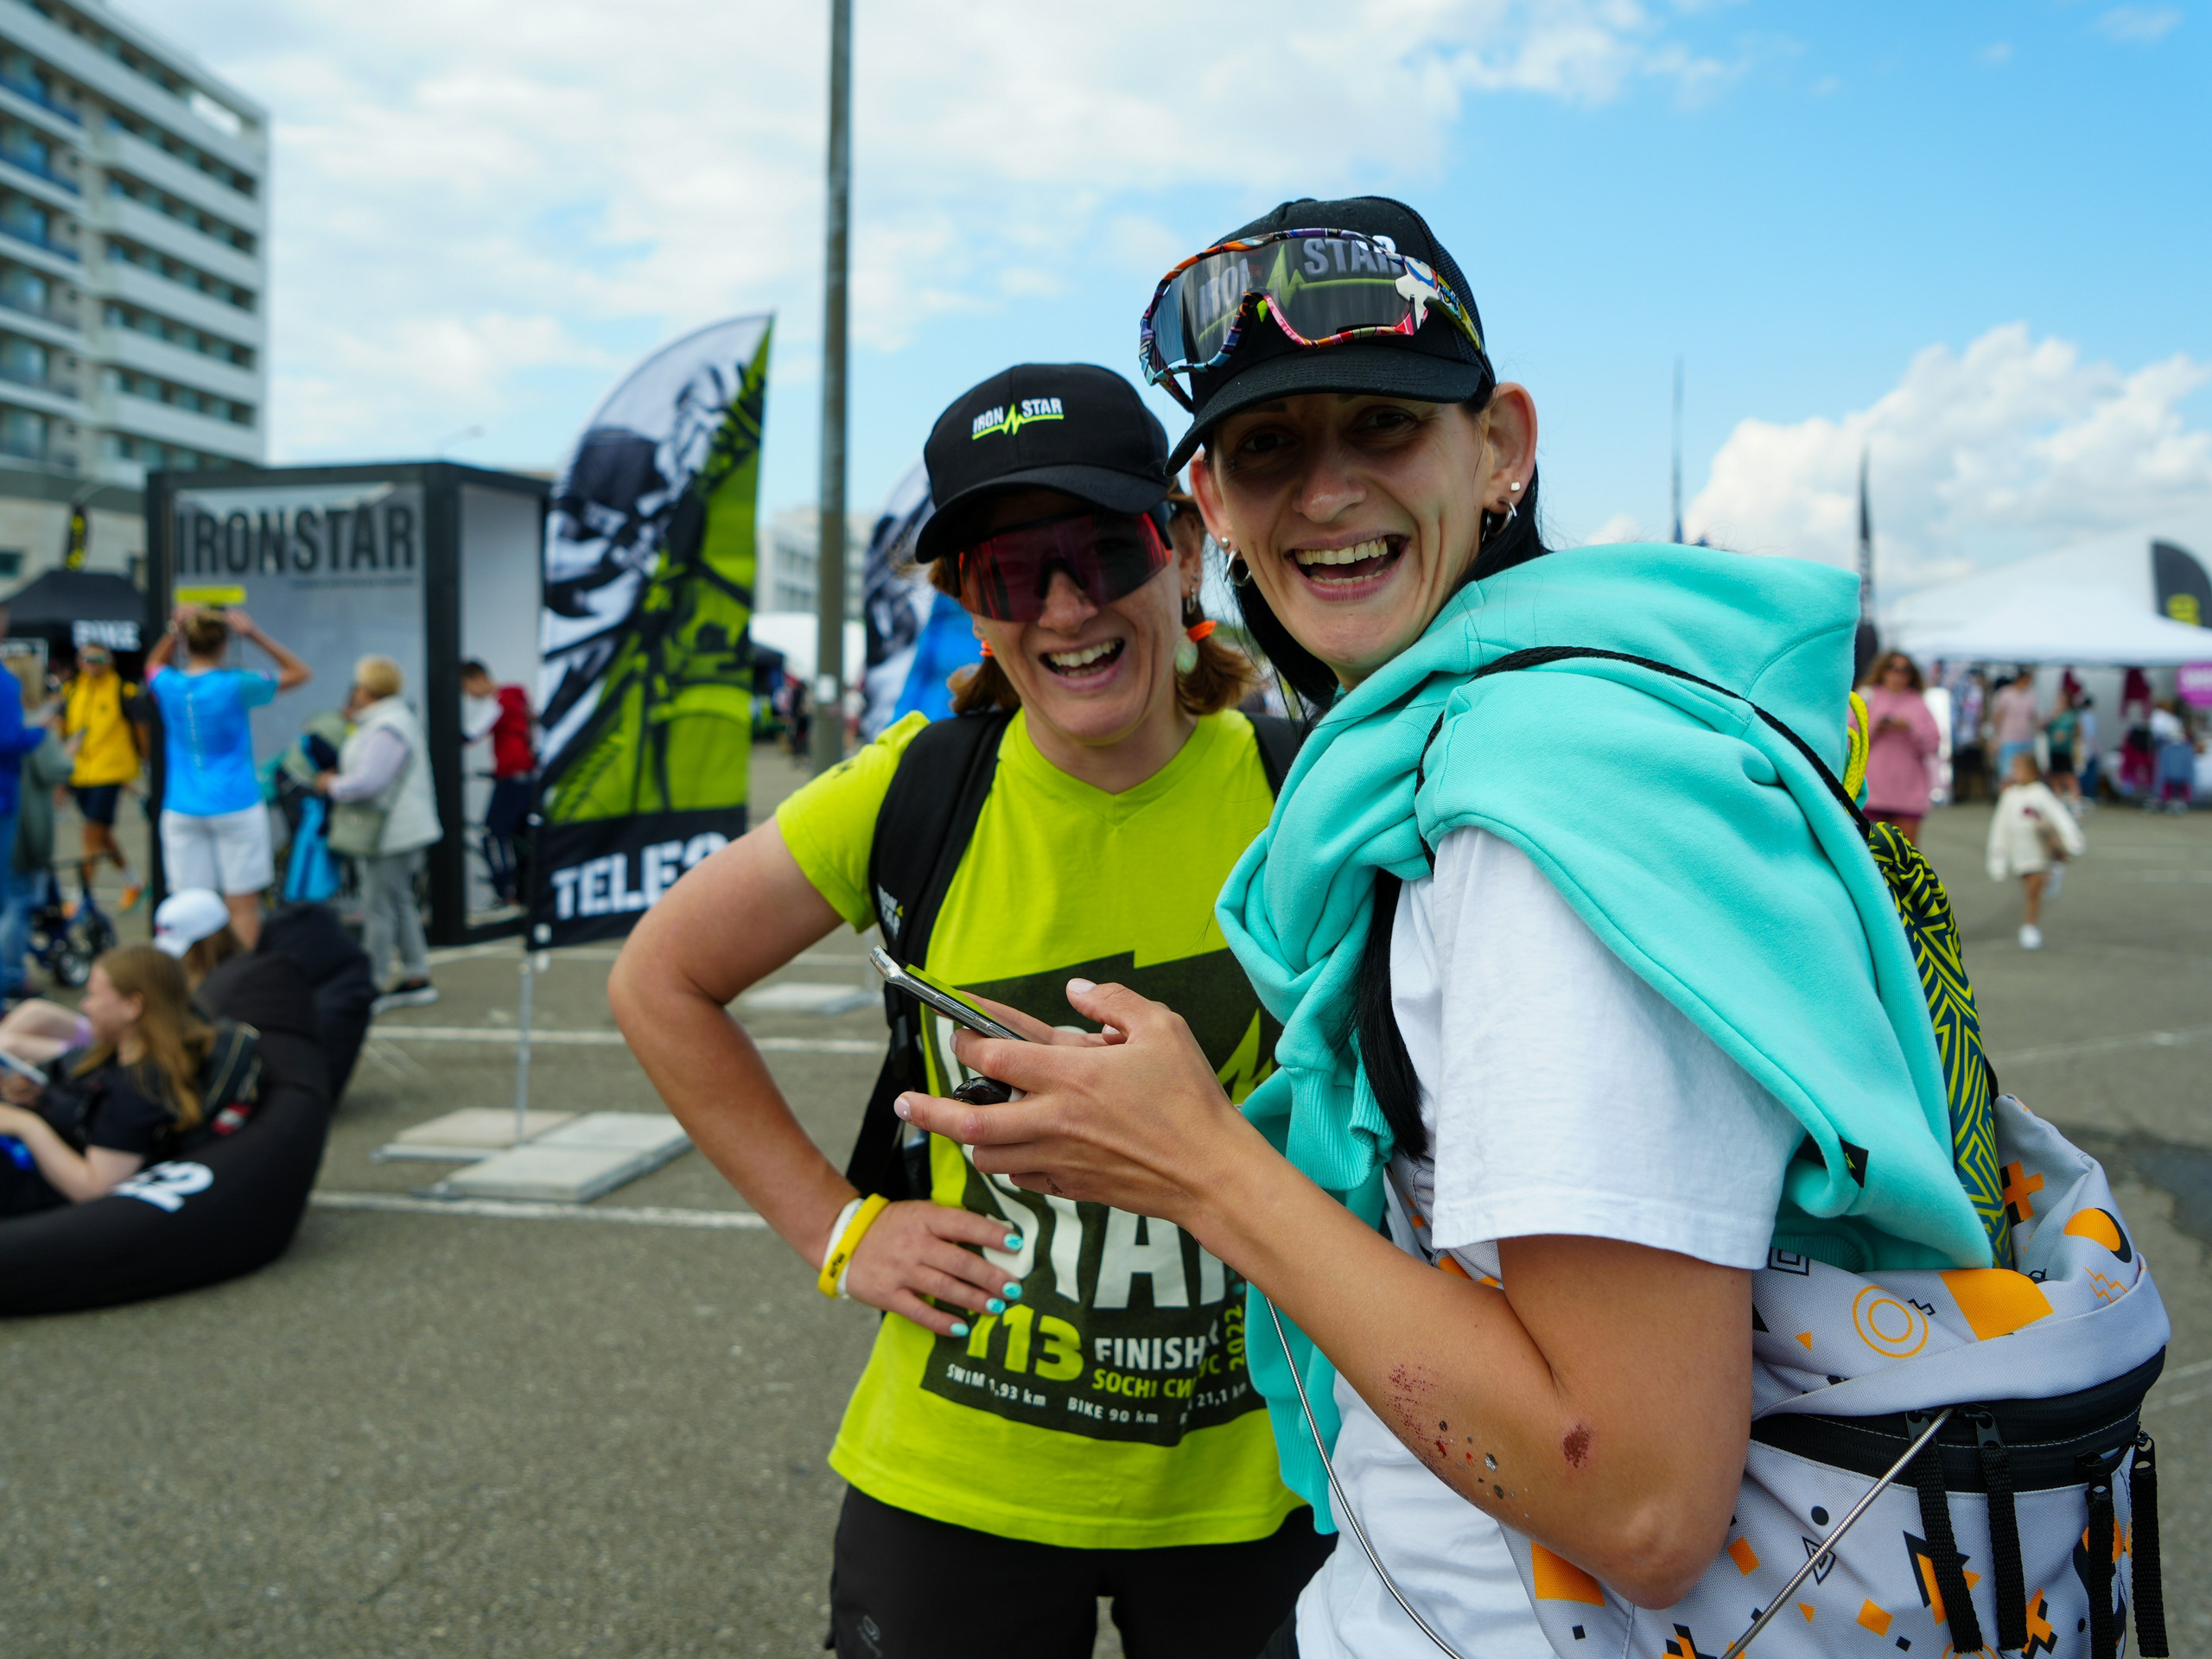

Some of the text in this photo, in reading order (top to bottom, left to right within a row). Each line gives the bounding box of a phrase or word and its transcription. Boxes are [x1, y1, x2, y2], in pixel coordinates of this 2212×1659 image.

[1303, 235, 1402, 276] STAR
[972, 397, 1063, 433] IRON STAR
[178, 504, 413, 574] IRONSTAR
[946, 1363, 986, 1389] SWIM
[989, 1377, 1019, 1400] 1,93
[1023, 1389, 1046, 1408] km
[1067, 1396, 1103, 1420] BIKE
[1109, 1408, 1129, 1423] 90
[1135, 1409, 1159, 1425] km
[1197, 1389, 1228, 1408] 21,1
[1091, 1368, 1158, 1399] SOCHI
